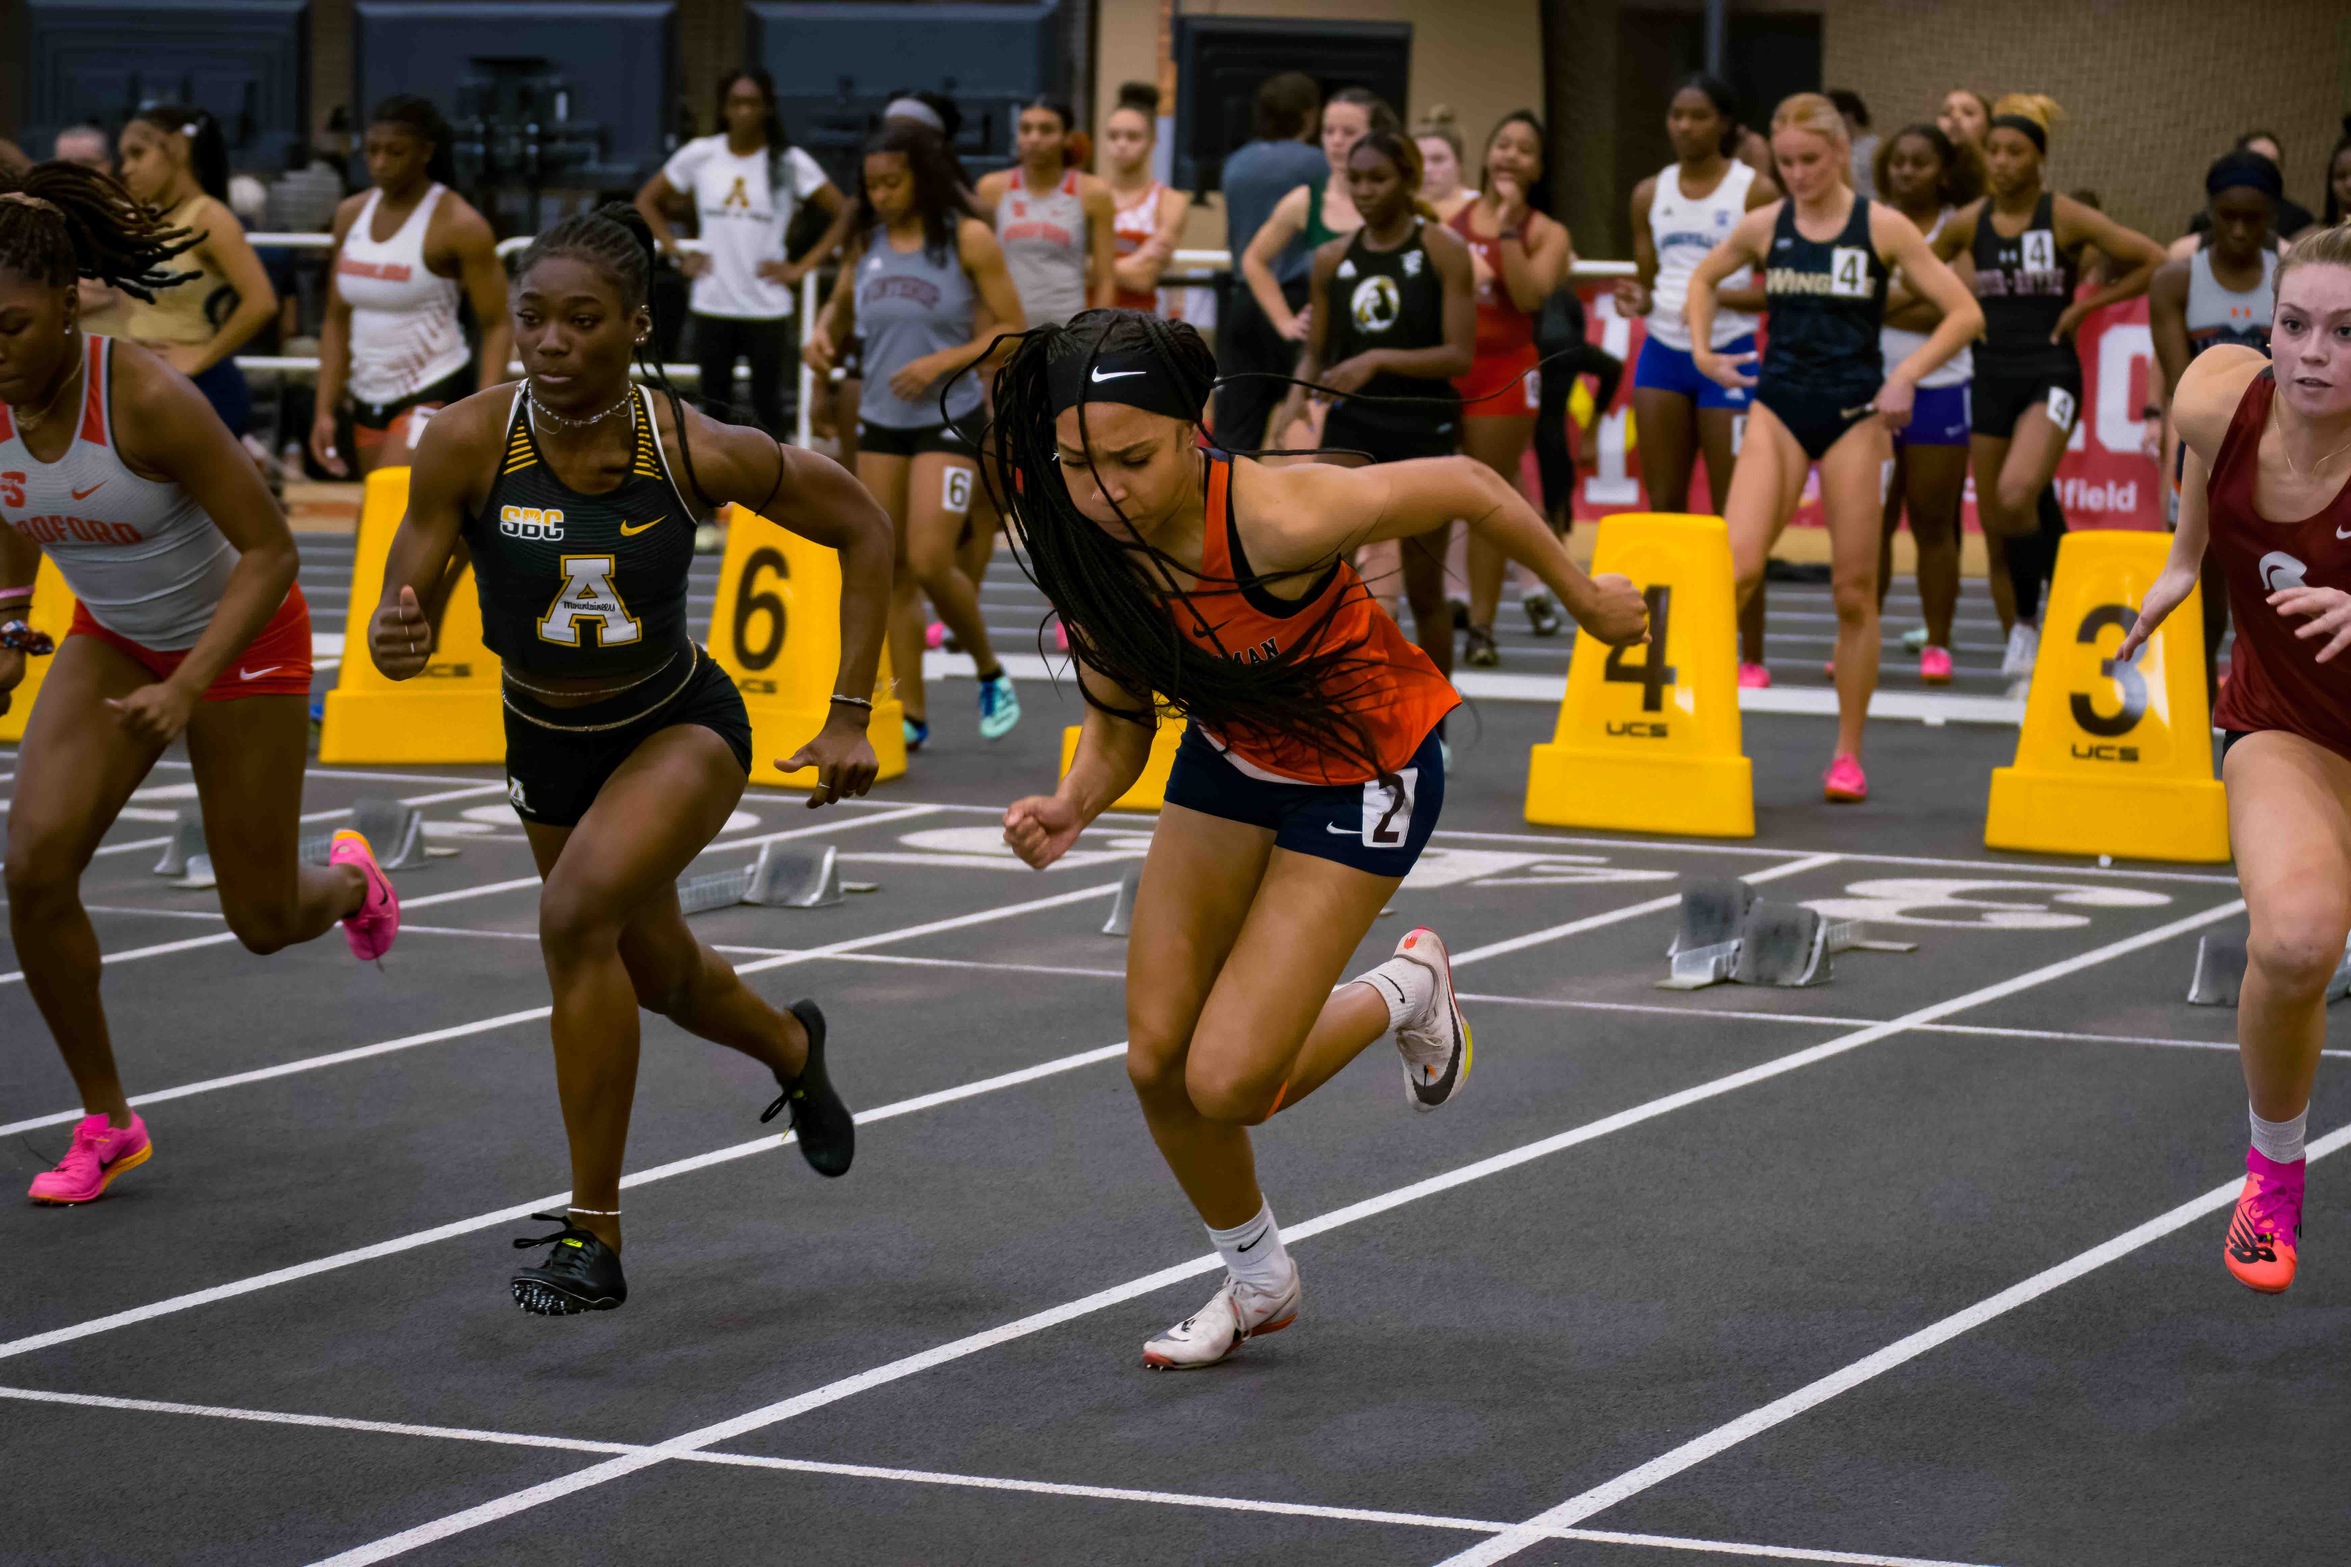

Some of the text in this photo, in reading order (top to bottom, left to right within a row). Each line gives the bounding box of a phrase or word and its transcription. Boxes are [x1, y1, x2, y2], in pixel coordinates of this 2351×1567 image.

[2030, 234, 2046, 269] 4
[1839, 254, 1861, 291] 4
[949, 472, 968, 507] 6
[500, 505, 564, 541] SBC
[536, 554, 642, 647] A
[733, 547, 790, 671] 6
[1604, 584, 1676, 712] 4
[735, 678, 777, 694] CS
[2069, 604, 2149, 736] 3
[1606, 721, 1668, 738] UCS
[2071, 744, 2139, 762] UCS
[1372, 773, 1406, 843] 2
